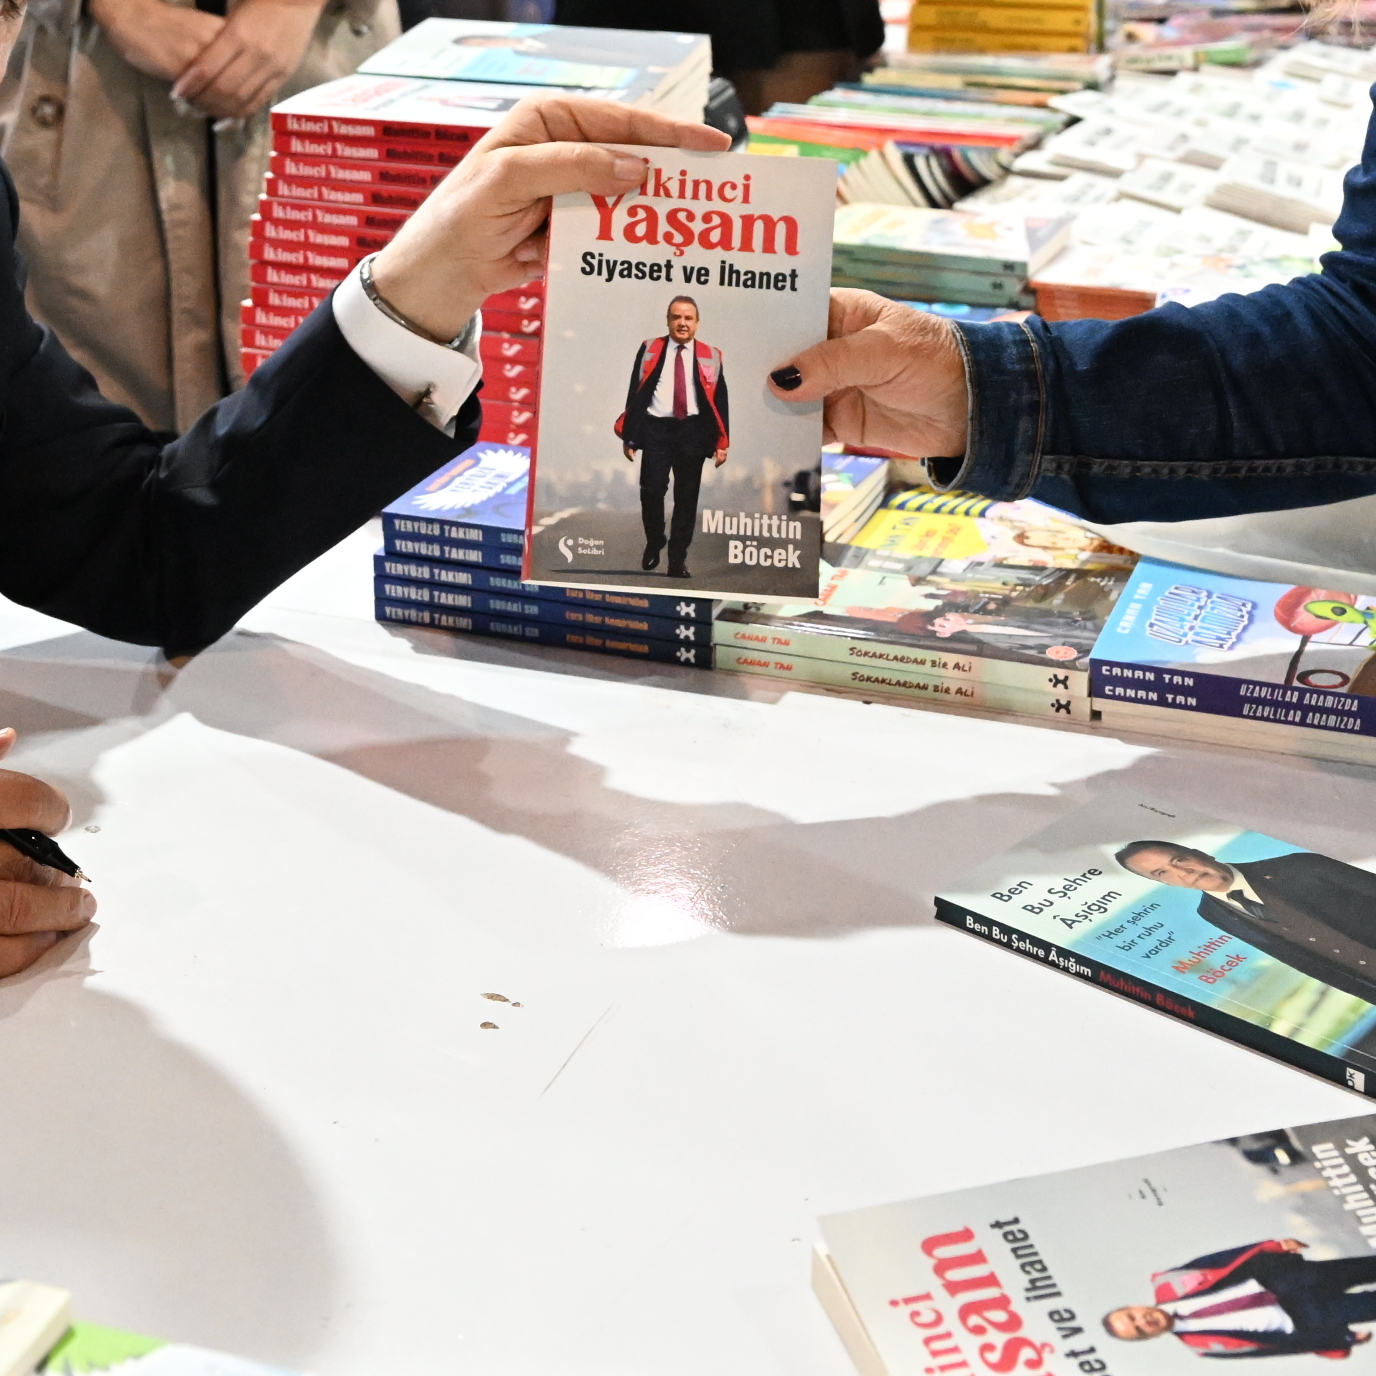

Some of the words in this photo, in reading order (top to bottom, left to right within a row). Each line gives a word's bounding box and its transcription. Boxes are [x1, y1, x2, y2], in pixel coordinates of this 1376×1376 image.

[287, 114, 329, 134] İkinci
[290, 137, 332, 156] İkinci
[284, 158, 327, 178] İkinci
[638, 157, 752, 204] İkinci
[590, 193, 801, 257] Yaşam
[580, 251, 674, 283] Siyaset
[682, 264, 710, 286] ve
[719, 260, 799, 292] İhanet
[394, 519, 440, 535] YERYÜZÜ
[443, 525, 483, 541] TAKIMI
[702, 509, 802, 539] Muhittin
[394, 539, 440, 556] YERYÜZÜ
[443, 545, 483, 563] TAKIMI
[578, 537, 604, 547] Doğan
[728, 540, 801, 568] Böcek
[384, 562, 430, 579] YERYÜZÜ
[433, 569, 472, 585] TAKIMI
[384, 584, 430, 601] YERYÜZÜ
[433, 590, 472, 608] TAKIMI
[384, 606, 430, 623] YERYÜZÜ
[734, 631, 769, 644] CANAN
[771, 635, 791, 647] TAN
[849, 646, 927, 667] SOKAKLARDAN
[736, 656, 770, 669] CANAN
[774, 661, 794, 672] TAN
[851, 671, 929, 692] SOKAKLARDAN
[1101, 665, 1155, 682] CANAN
[1163, 673, 1195, 687] TAN
[1239, 683, 1299, 704] UZAYLILAR
[1303, 689, 1358, 711] ARAMIZDA
[1104, 685, 1158, 701] CANAN
[1166, 693, 1197, 706] TAN
[1242, 703, 1302, 723] UZAYLILAR
[1306, 710, 1361, 731] ARAMIZDA
[990, 878, 1034, 904] Ben
[1021, 896, 1054, 916] Bu
[1051, 865, 1103, 901] Şehre
[1051, 888, 1123, 930] Âşığım
[1130, 901, 1162, 926] şehrin
[1116, 936, 1137, 953] bir
[1138, 921, 1165, 940] ruhu
[966, 915, 989, 936] Ben
[992, 926, 1008, 943] Bu
[1011, 934, 1045, 959] Şehre
[1048, 947, 1092, 977] Âşığım
[1099, 970, 1152, 1001] Muhittin
[1156, 992, 1197, 1020] Böcek
[1171, 933, 1234, 974] Muhittin
[1198, 952, 1249, 985] Böcek
[990, 1216, 1063, 1304] İhanet
[1047, 1307, 1085, 1342] ve
